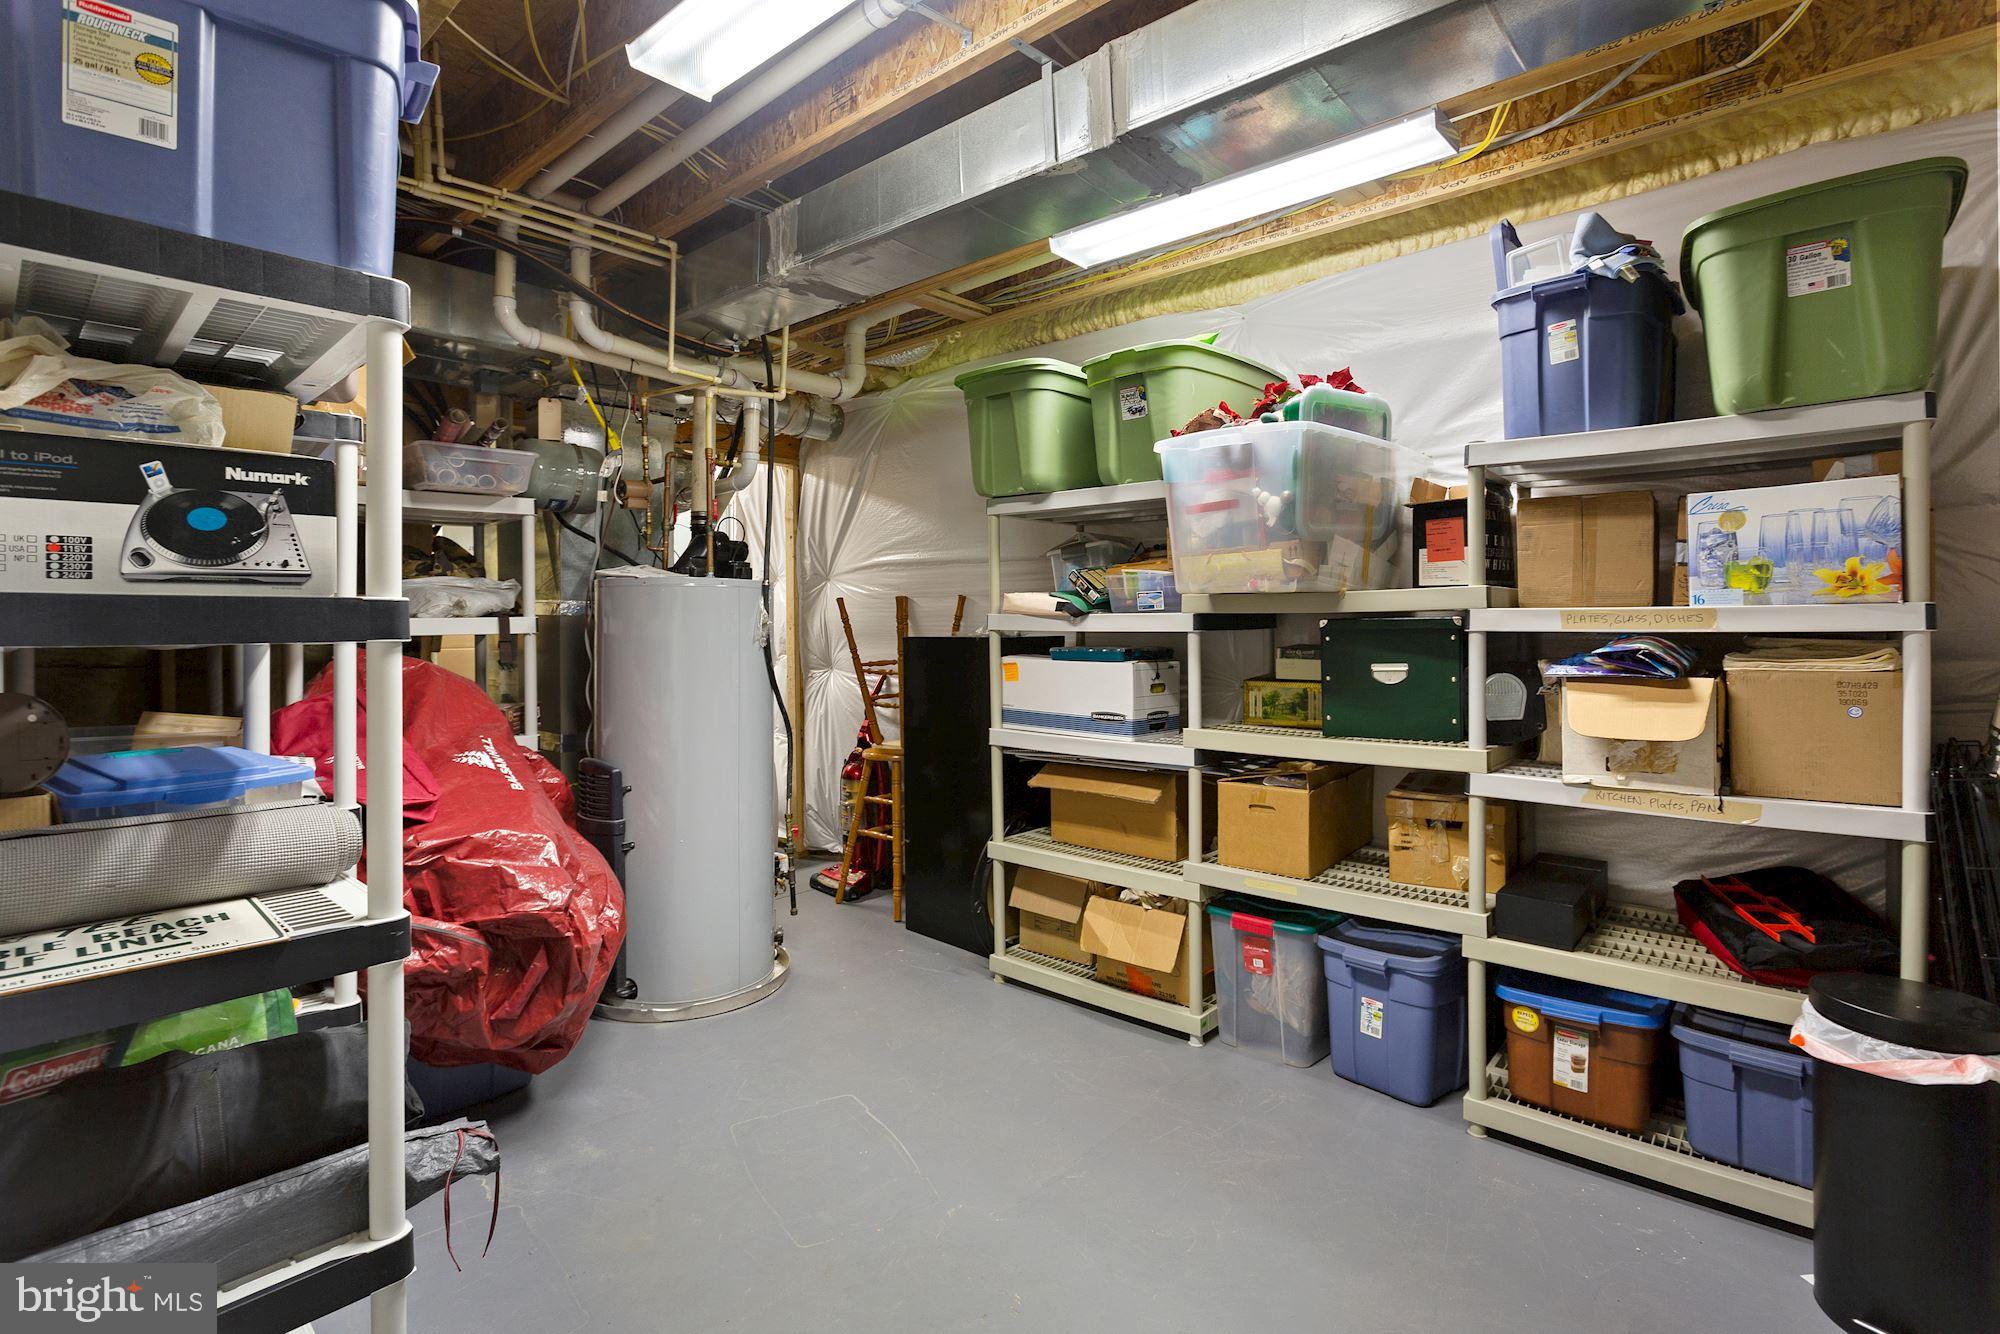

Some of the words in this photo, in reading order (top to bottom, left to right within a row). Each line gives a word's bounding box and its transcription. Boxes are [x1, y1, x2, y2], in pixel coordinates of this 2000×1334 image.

[79, 0, 130, 20] Rubbermaid
[77, 14, 147, 42] ROUGHNECK
[84, 61, 98, 71] gal
[1788, 255, 1797, 263] 30
[1800, 251, 1822, 261] Gallon
[10, 450, 29, 460] to
[34, 451, 78, 465] iPod.
[225, 466, 309, 486] Numark
[62, 536, 87, 544] 100V
[62, 545, 87, 553] 115V
[62, 554, 87, 562] 220V
[62, 563, 87, 571] 230V
[62, 572, 87, 580] 240V
[1692, 594, 1706, 606] 16
[1655, 613, 1704, 623] DISHES
[92, 912, 230, 944] BEACH
[76, 926, 208, 958] LINKS
[42, 961, 117, 980] Register
[127, 957, 143, 965] at
[154, 950, 182, 959] Pro
[8, 1055, 99, 1094] Coleman
